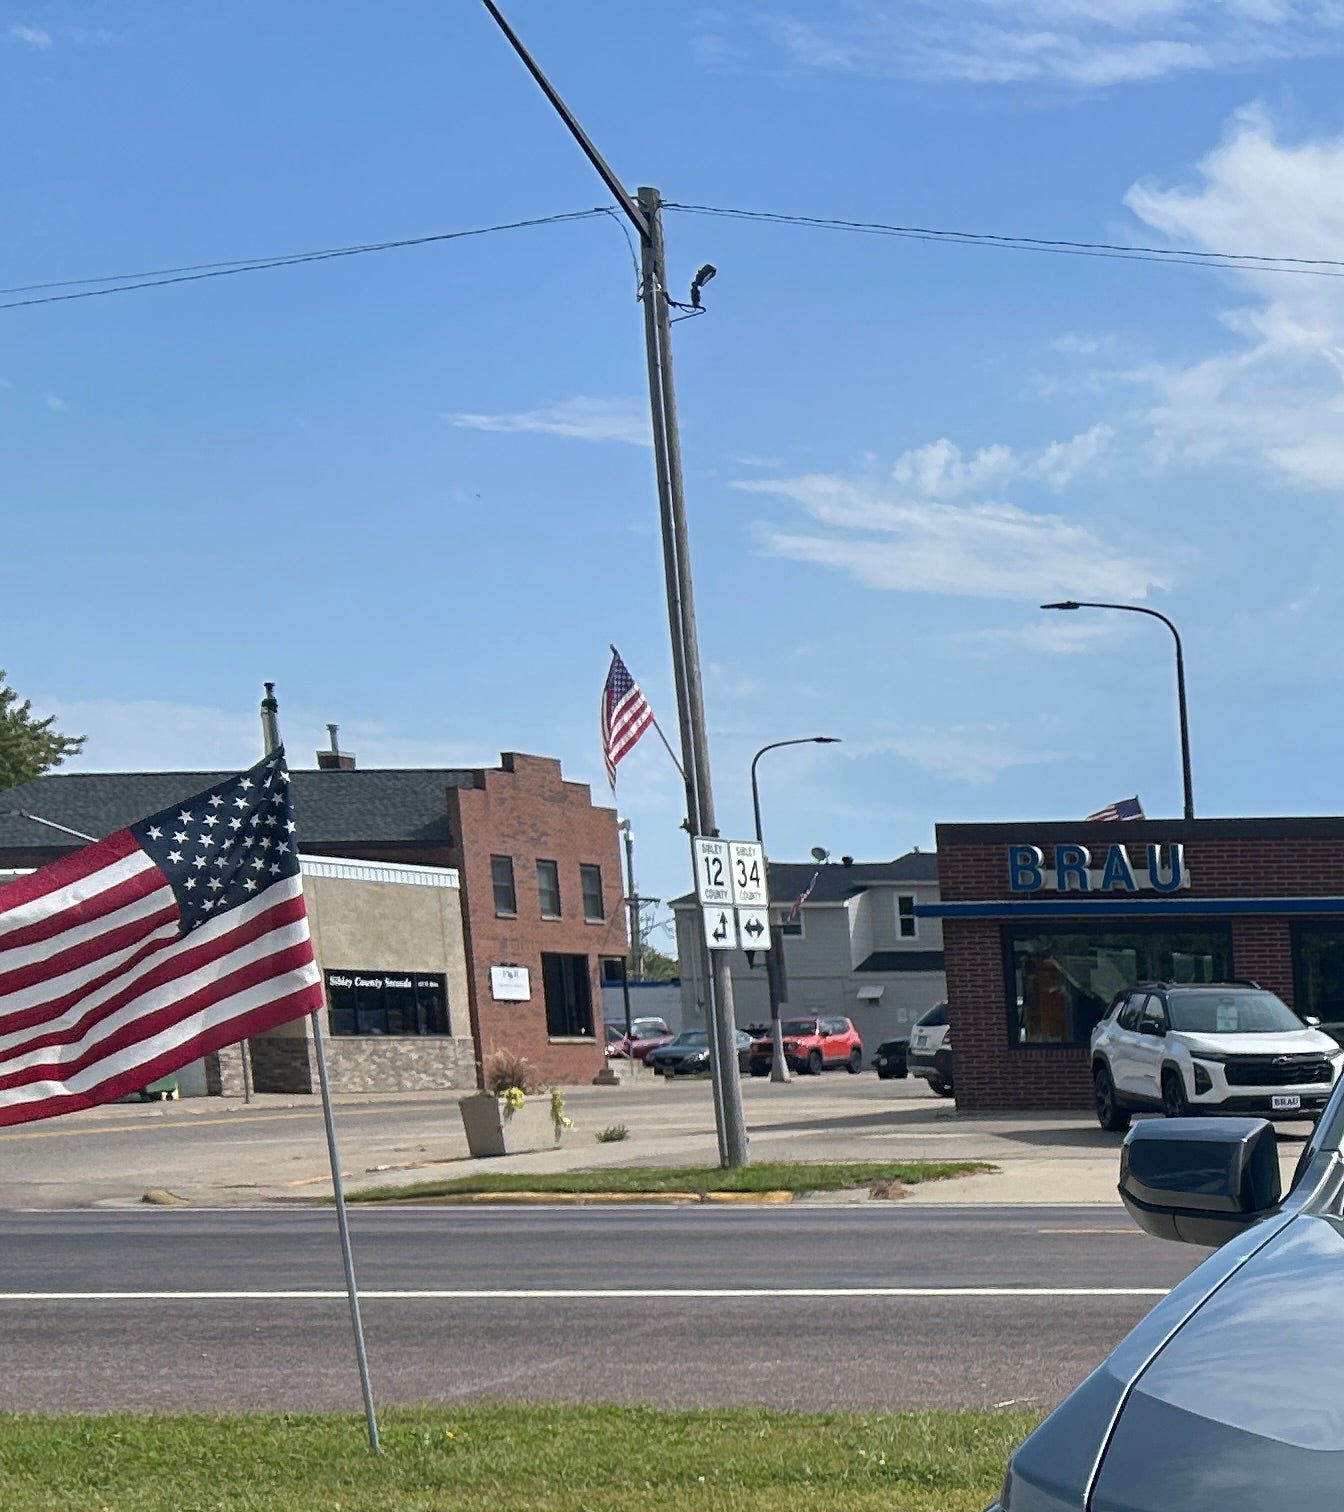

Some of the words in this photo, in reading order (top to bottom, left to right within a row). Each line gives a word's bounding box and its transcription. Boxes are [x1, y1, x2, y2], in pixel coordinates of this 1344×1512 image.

[702, 843, 722, 854] SIBLEY
[736, 847, 755, 856] SIBLEY
[705, 856, 724, 886] 12
[1009, 843, 1184, 892] BRAU
[737, 859, 760, 888] 34
[705, 889, 728, 900] COUNTY
[740, 891, 761, 901] COUNTY
[1274, 1097, 1298, 1106] BRAU
